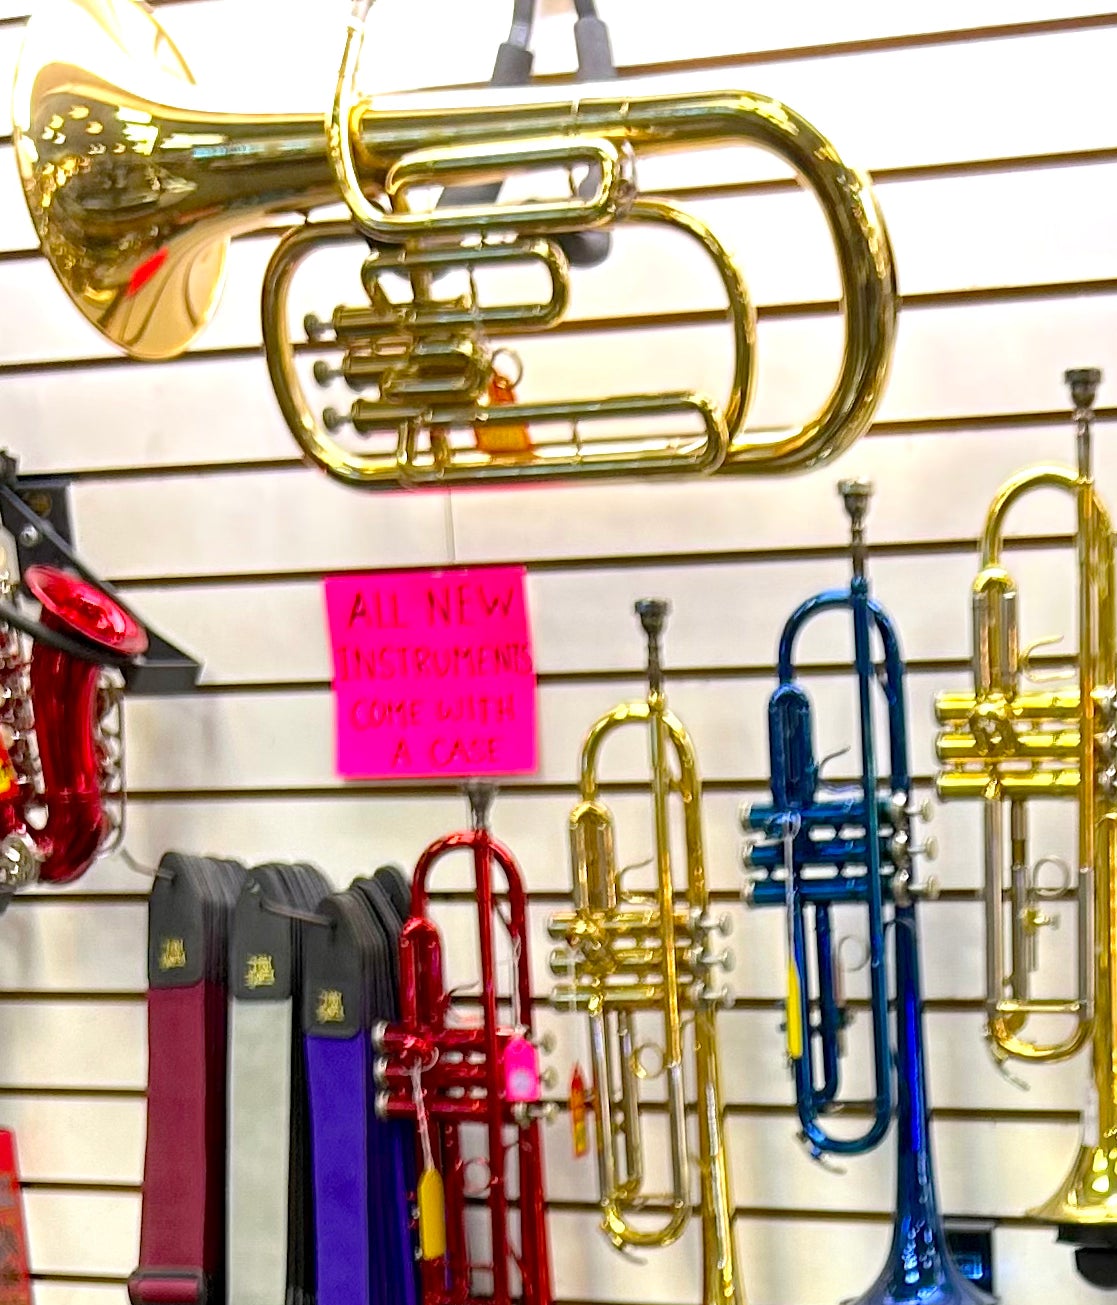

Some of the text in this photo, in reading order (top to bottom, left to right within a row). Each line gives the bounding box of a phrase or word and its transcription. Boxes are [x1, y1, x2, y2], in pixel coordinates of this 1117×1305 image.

[348, 583, 514, 629] ALL NEW
[336, 642, 533, 681] INSTRUMENTS
[352, 694, 515, 731] COME WITH
[391, 736, 502, 769] A CASE
